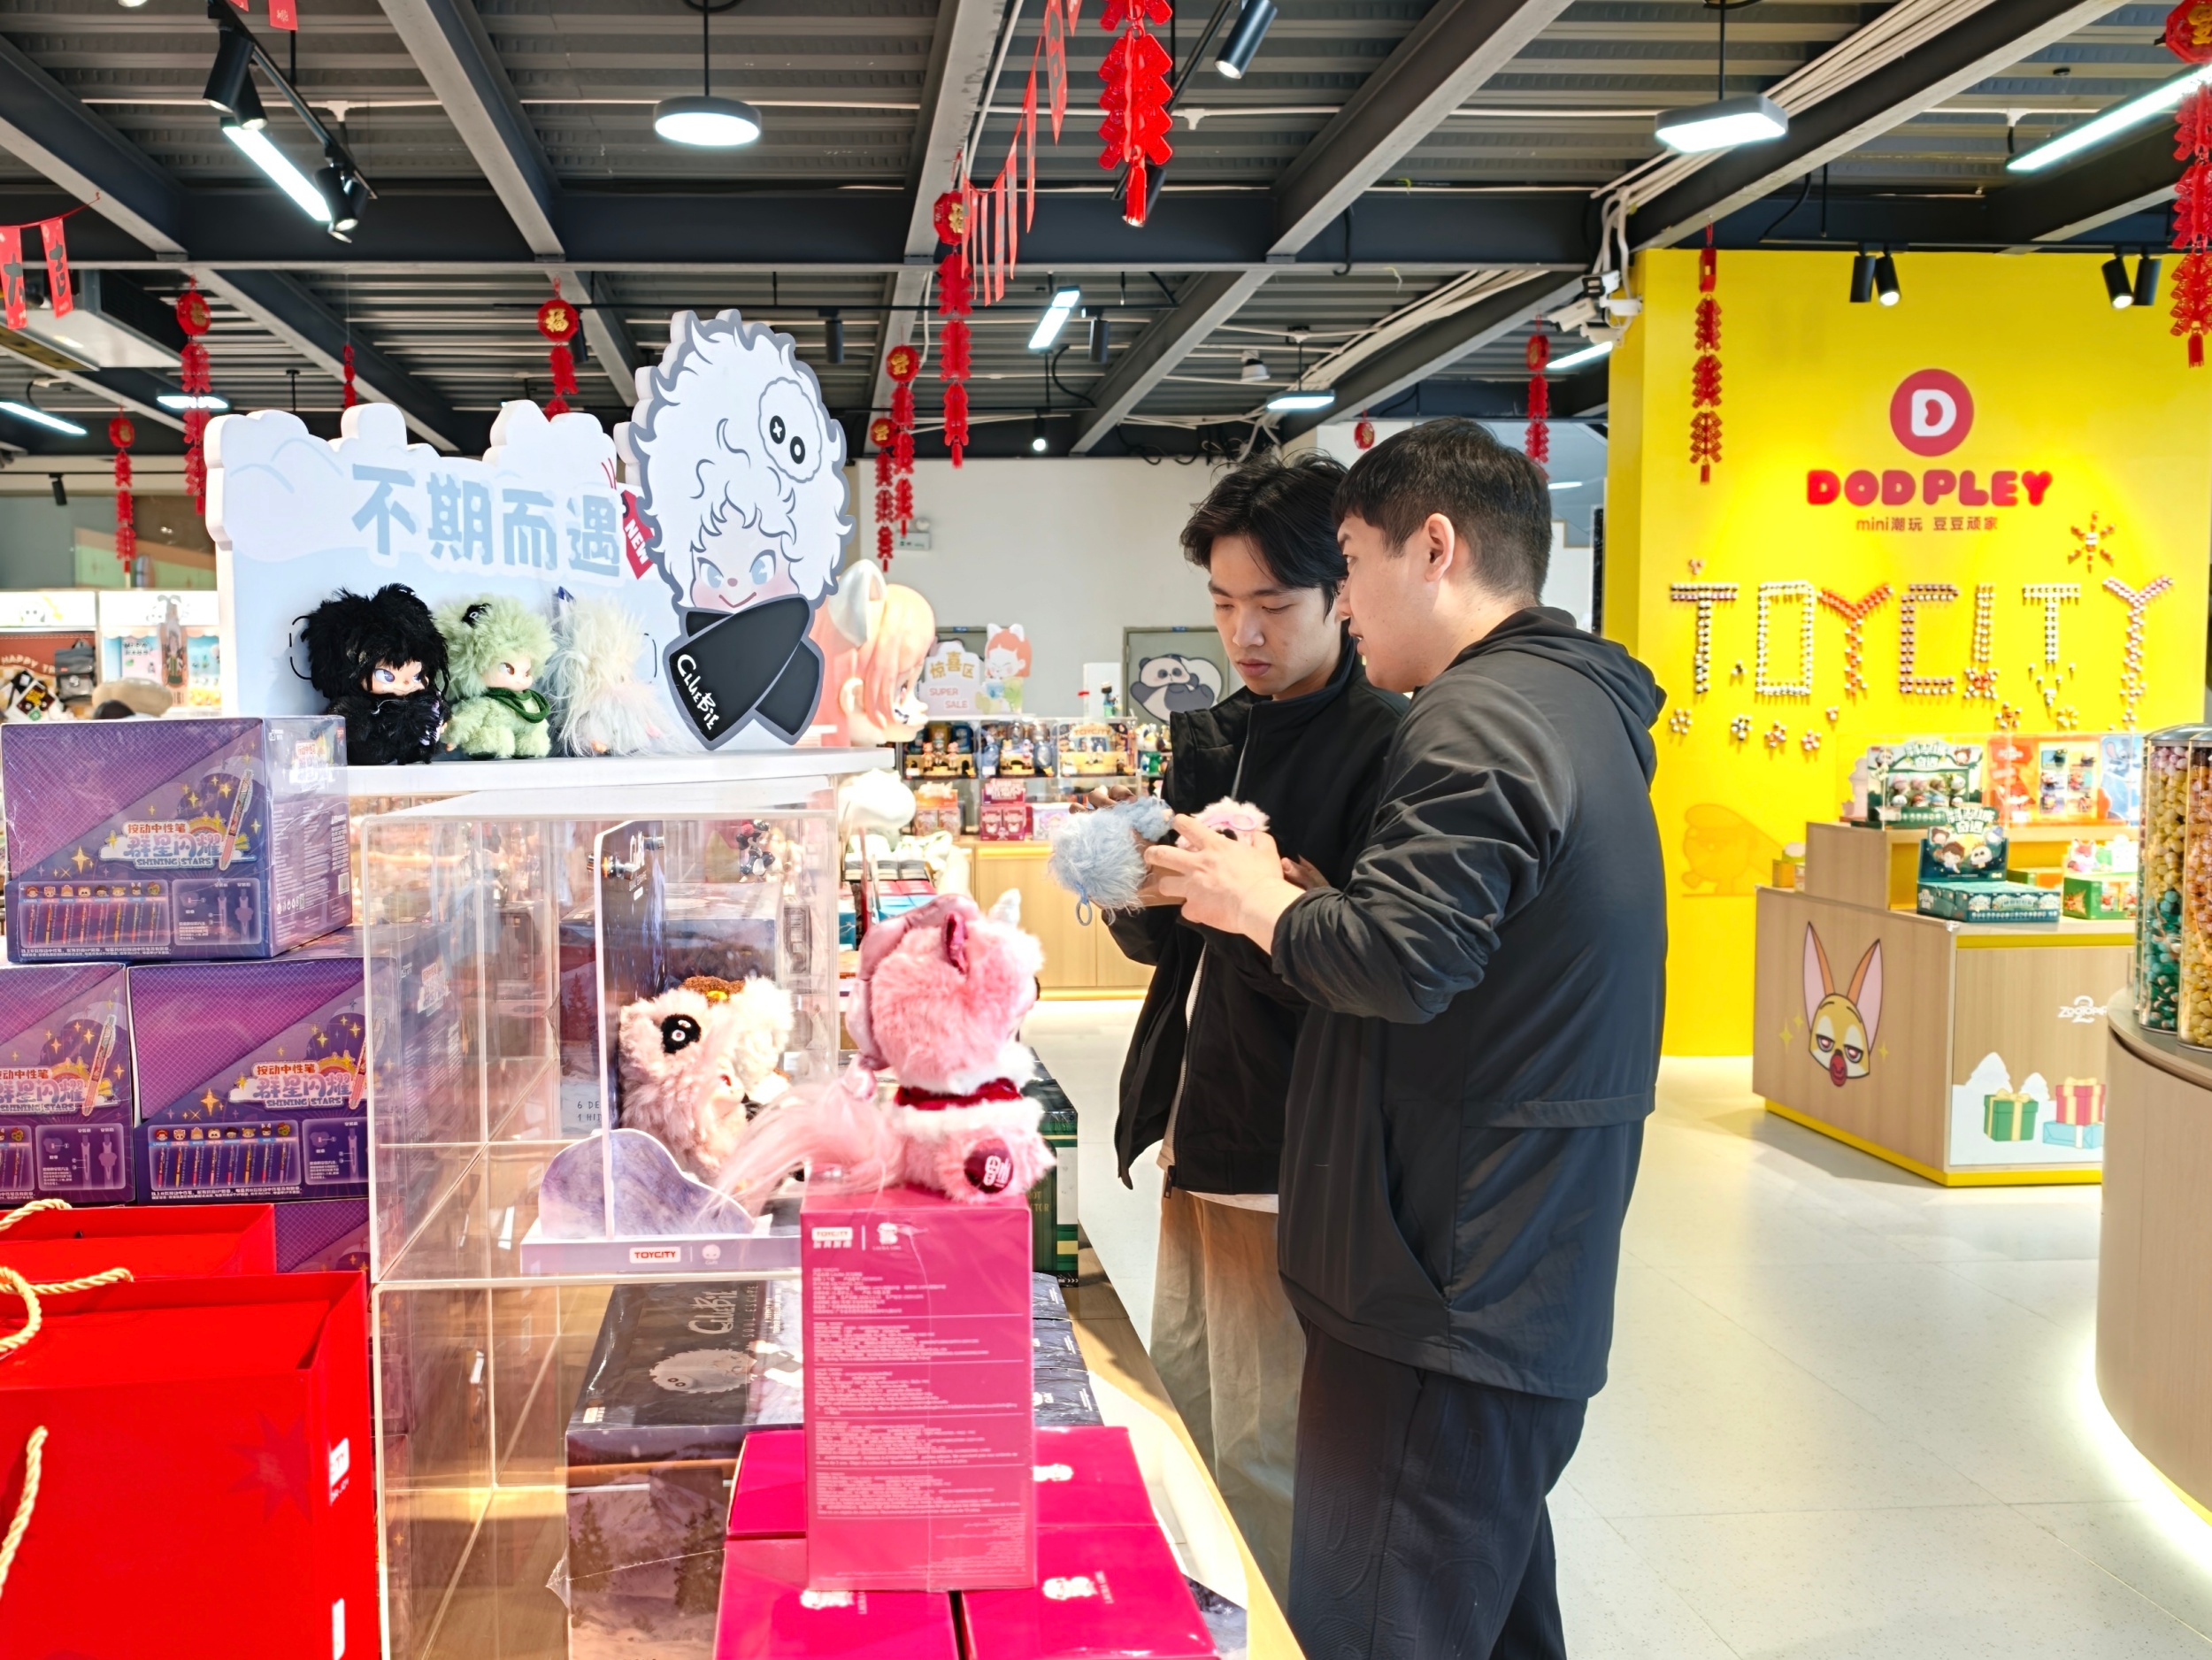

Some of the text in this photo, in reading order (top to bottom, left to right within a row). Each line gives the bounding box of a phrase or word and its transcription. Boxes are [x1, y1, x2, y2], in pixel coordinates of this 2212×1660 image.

[1911, 388, 1957, 436] D
[350, 464, 621, 578] 不期而遇
[1933, 516, 1999, 531] 豆豆顽家
[624, 519, 649, 565] NEW
[1, 654, 57, 674] HAPPY TR
[930, 650, 975, 680] 惊喜区
[929, 688, 958, 696] SUPER
[945, 700, 968, 709] SALE
[127, 823, 186, 834] 按动中性笔
[123, 834, 223, 857] 群星闪耀
[136, 857, 211, 866] SHINING STARS
[0, 1069, 49, 1080] 动中性笔
[257, 1064, 316, 1075] 按动中性笔
[253, 1072, 352, 1098] 群星闪耀
[0, 1103, 74, 1112] SHINING STARS
[266, 1098, 308, 1107] SHINING
[577, 1100, 583, 1110] 6
[577, 1113, 582, 1122] 1
[742, 1285, 758, 1338] SOUL ESCAPE
